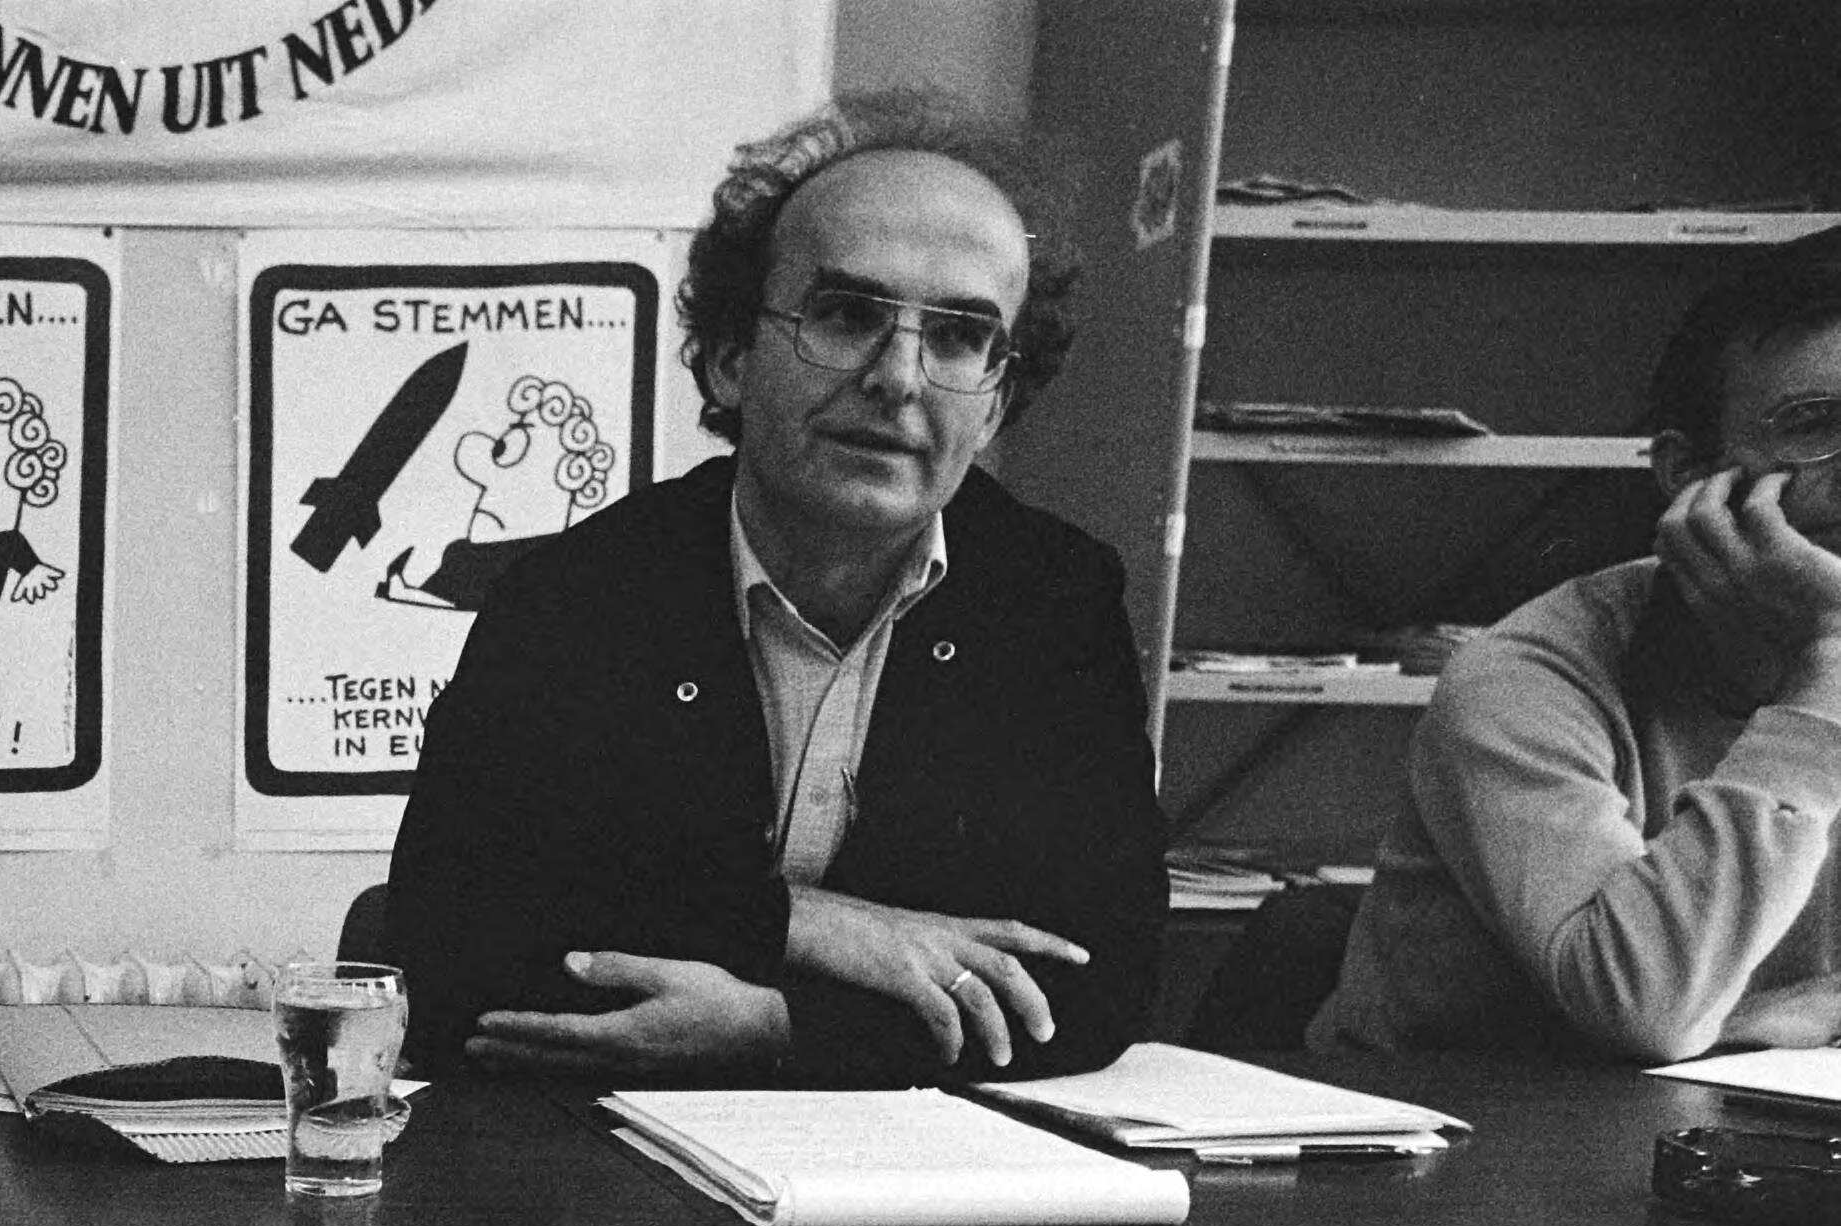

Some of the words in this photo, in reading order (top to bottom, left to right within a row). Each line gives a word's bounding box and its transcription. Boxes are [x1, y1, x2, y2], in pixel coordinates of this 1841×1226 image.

[160, 46, 268, 134] UIT
[281, 0, 435, 100] NED
[277, 297, 347, 336] GA
[335, 736, 365, 756] IN
